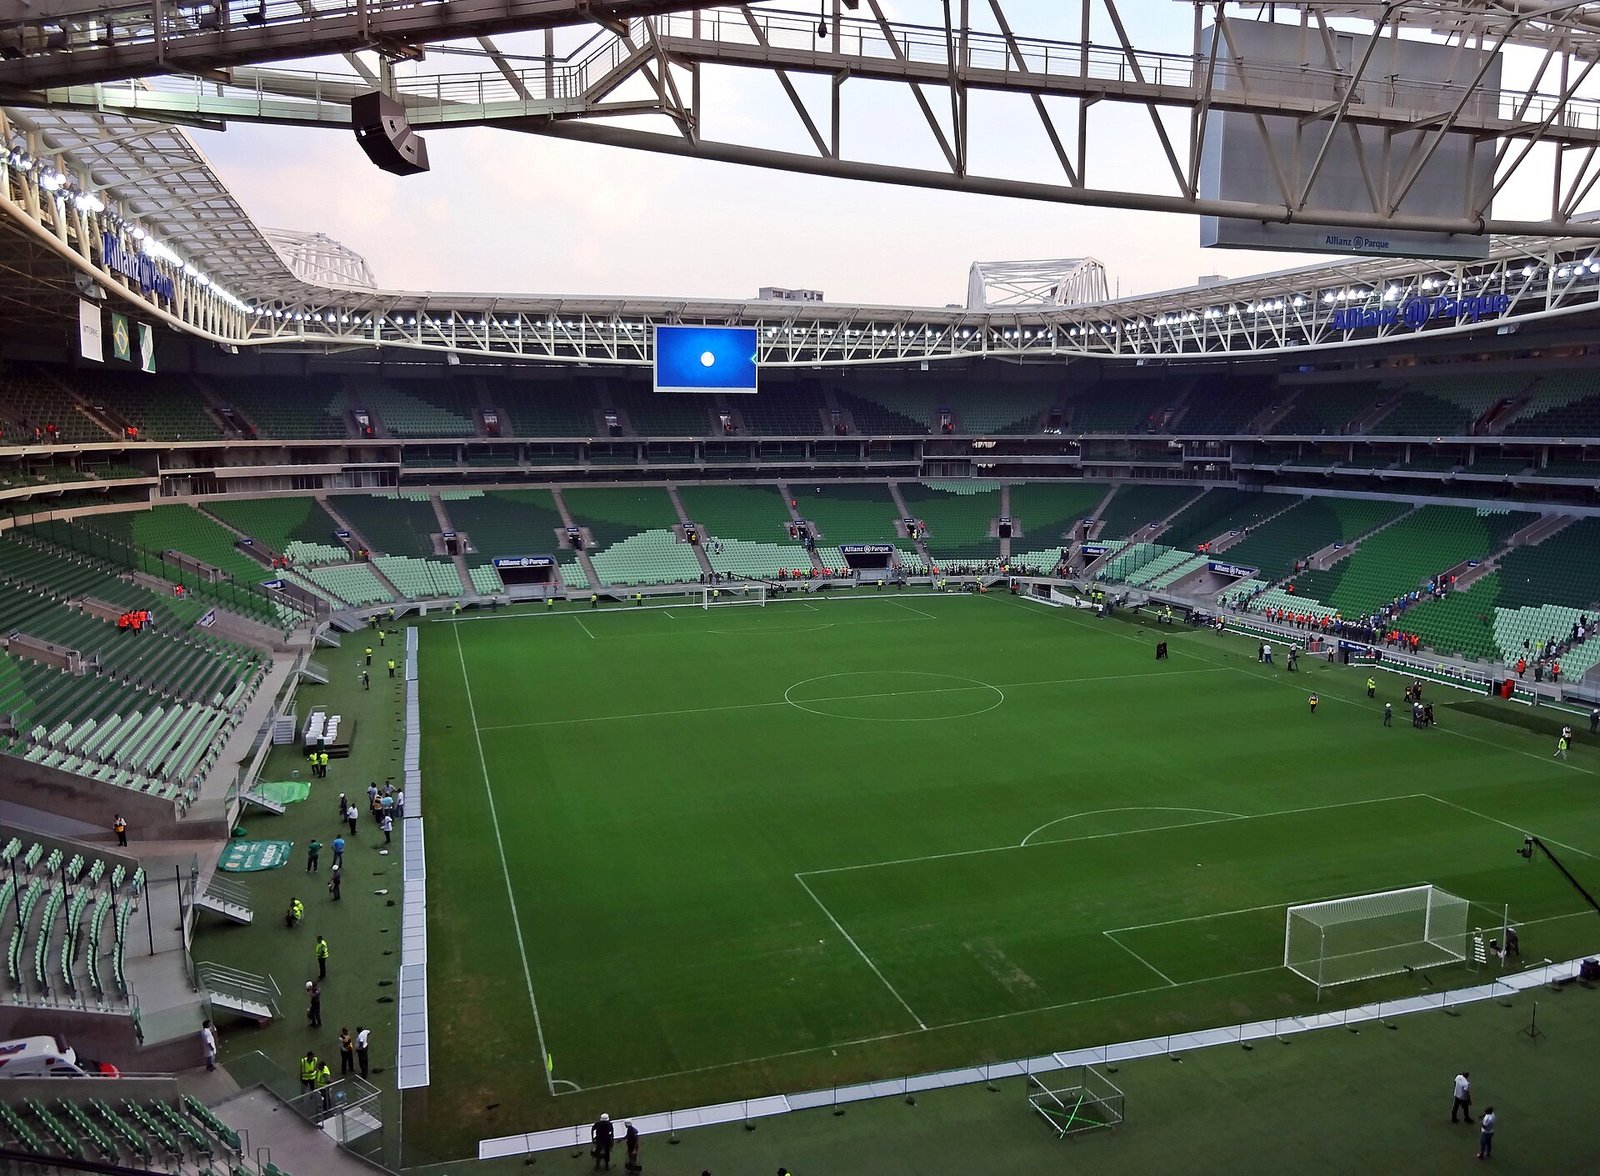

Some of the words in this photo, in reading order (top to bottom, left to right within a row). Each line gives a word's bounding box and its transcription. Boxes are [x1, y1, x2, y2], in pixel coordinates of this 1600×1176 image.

[1325, 236, 1352, 246] Allianz
[1364, 238, 1389, 250] Parque
[1330, 307, 1399, 330] Allianz
[1434, 294, 1509, 321] Parque
